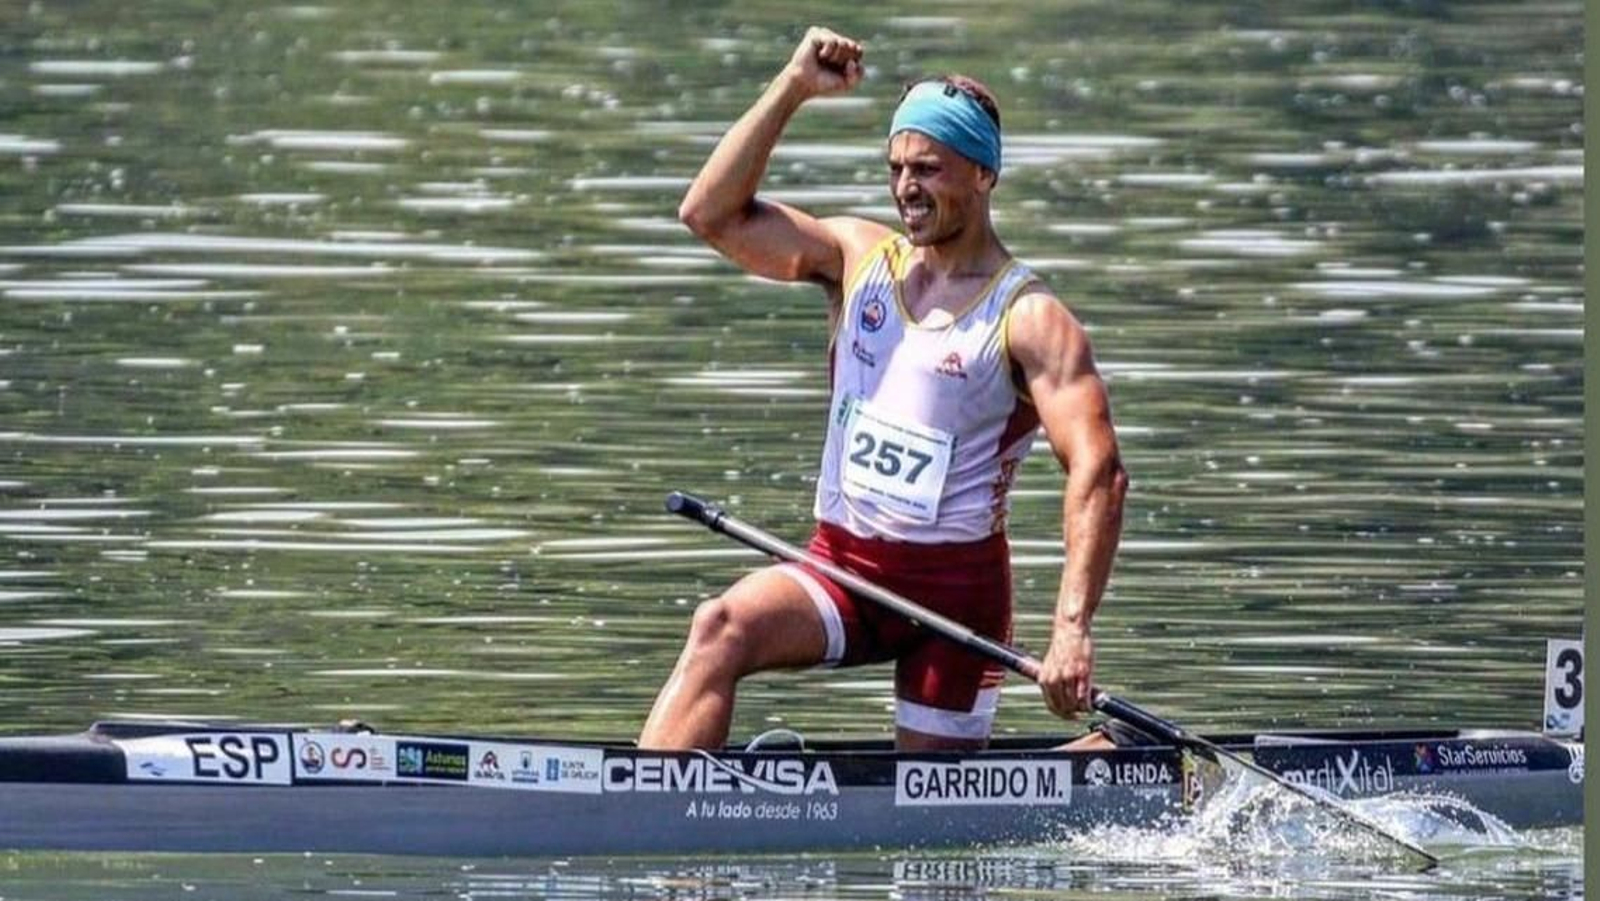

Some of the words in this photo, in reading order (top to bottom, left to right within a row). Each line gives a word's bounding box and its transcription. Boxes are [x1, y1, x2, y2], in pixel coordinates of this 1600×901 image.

[849, 430, 934, 485] 257
[1554, 648, 1583, 710] 3
[185, 735, 280, 780] ESP
[1437, 743, 1528, 766] StarServicios
[603, 757, 840, 796] CEMEVISA
[904, 766, 1029, 799] GARRIDO
[1035, 766, 1064, 799] M.
[1115, 763, 1171, 786] LENDA
[685, 801, 698, 818] A
[700, 801, 714, 818] tu
[717, 800, 753, 819] lado
[754, 802, 801, 820] desde
[805, 801, 839, 821] 1963
